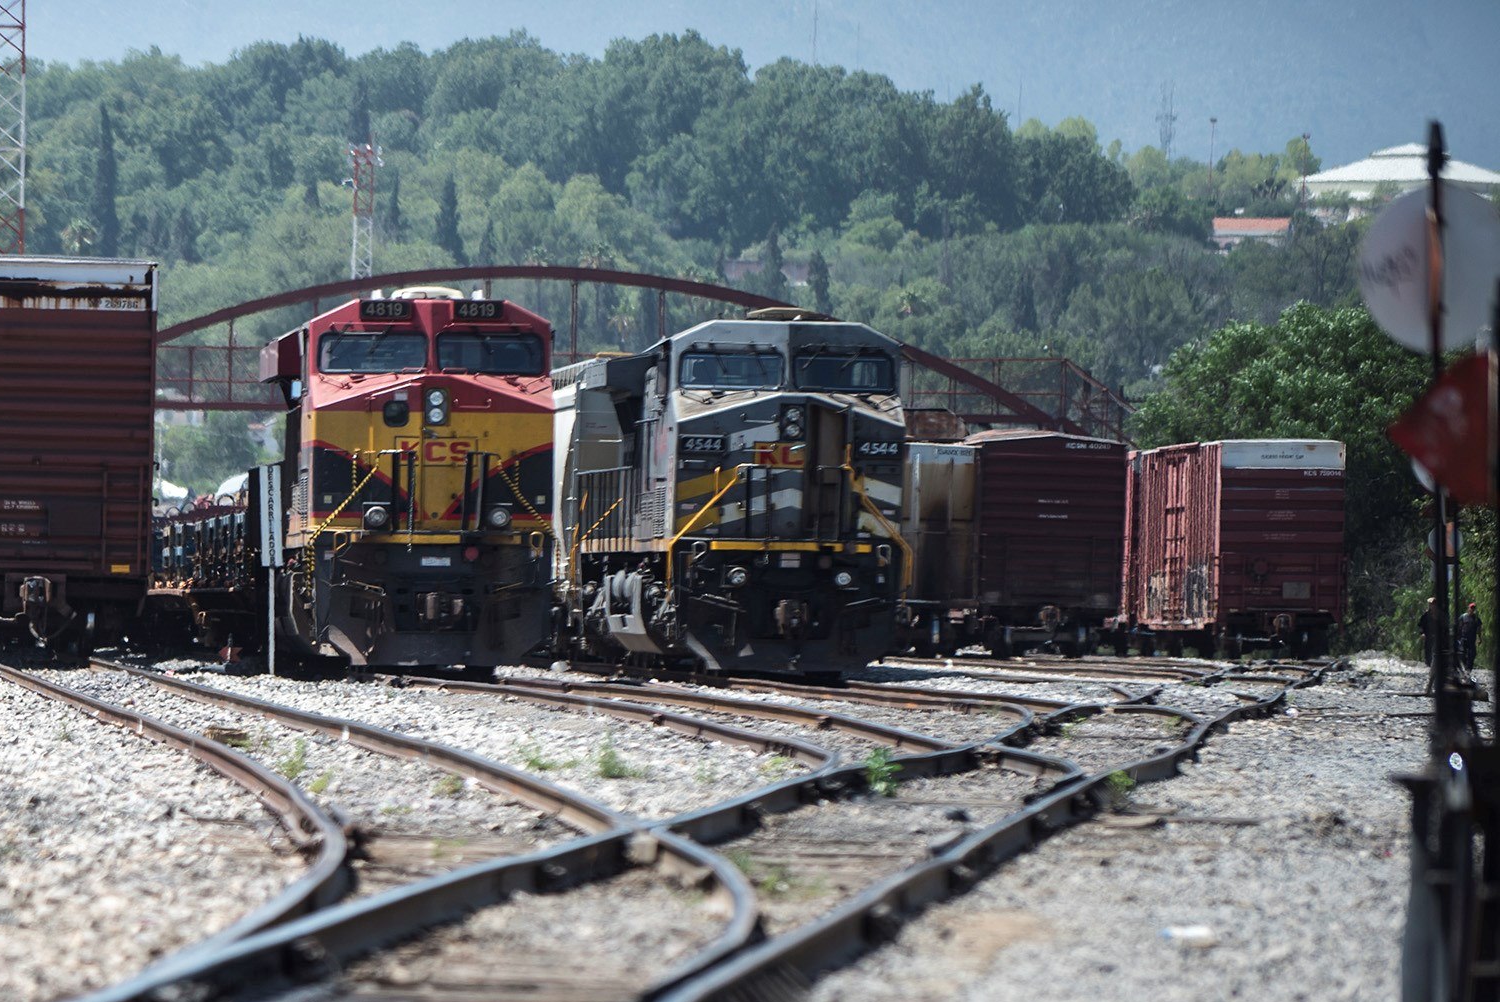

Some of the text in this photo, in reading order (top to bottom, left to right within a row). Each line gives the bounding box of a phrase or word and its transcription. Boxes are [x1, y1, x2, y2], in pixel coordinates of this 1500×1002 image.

[366, 303, 403, 316] 4819
[459, 303, 495, 316] 4819
[683, 438, 722, 451] 4544
[860, 442, 899, 455] 4544
[401, 441, 471, 462] KCS
